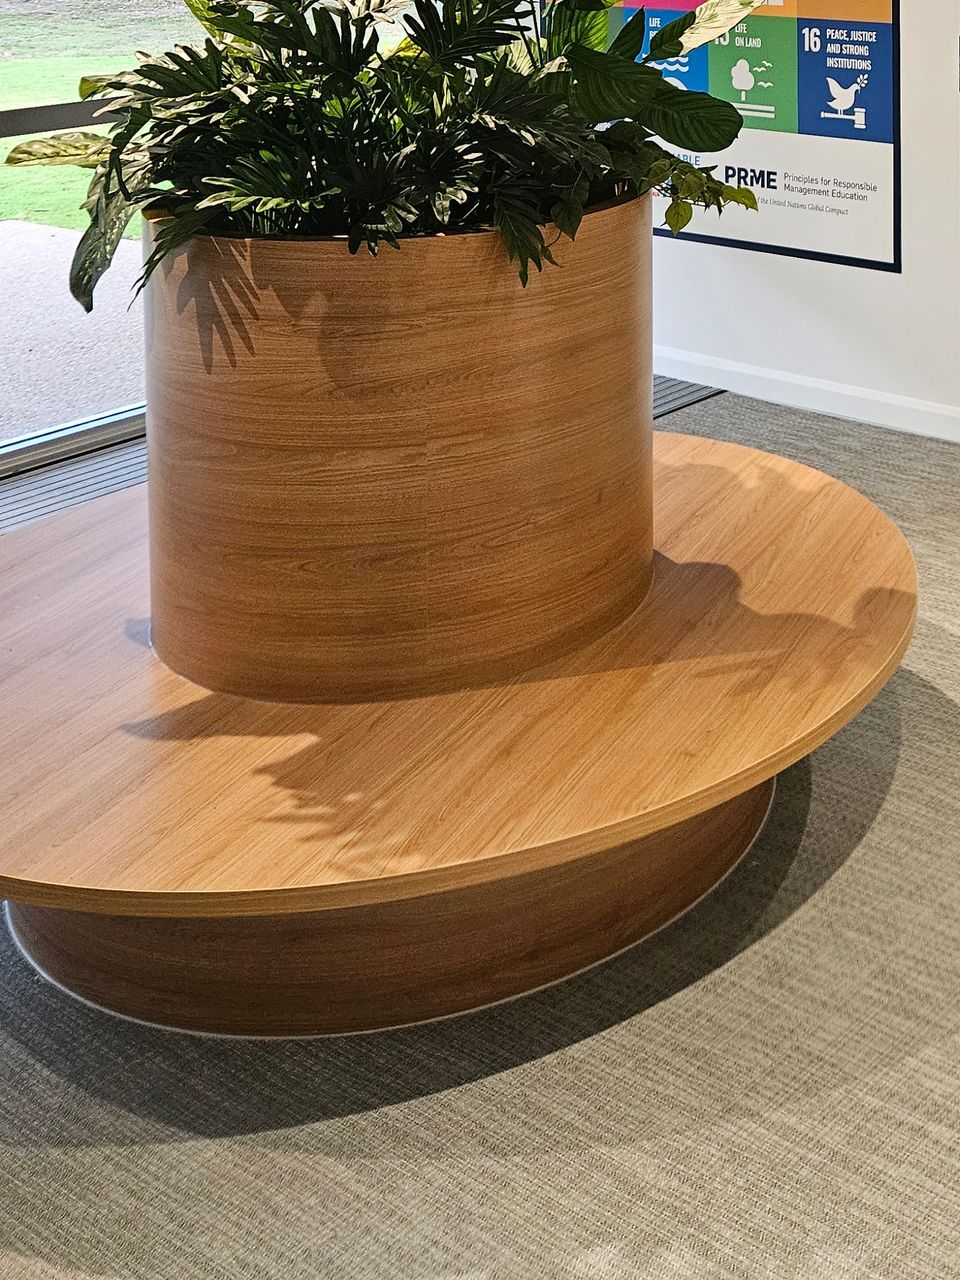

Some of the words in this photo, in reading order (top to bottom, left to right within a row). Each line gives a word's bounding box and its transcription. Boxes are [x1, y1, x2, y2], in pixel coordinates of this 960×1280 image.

[649, 18, 660, 27] LIFE
[802, 27, 821, 52] 16
[827, 29, 849, 41] PEACE,
[850, 31, 877, 42] JUSTICE
[735, 37, 744, 47] ON
[745, 38, 761, 48] LAND
[826, 44, 840, 54] AND
[841, 45, 869, 56] STRONG
[827, 57, 872, 70] INSTITUTIONS
[784, 172, 819, 185] Principles
[821, 177, 831, 186] for
[834, 179, 878, 192] Responsible
[784, 183, 830, 197] Management
[832, 190, 868, 202] Education
